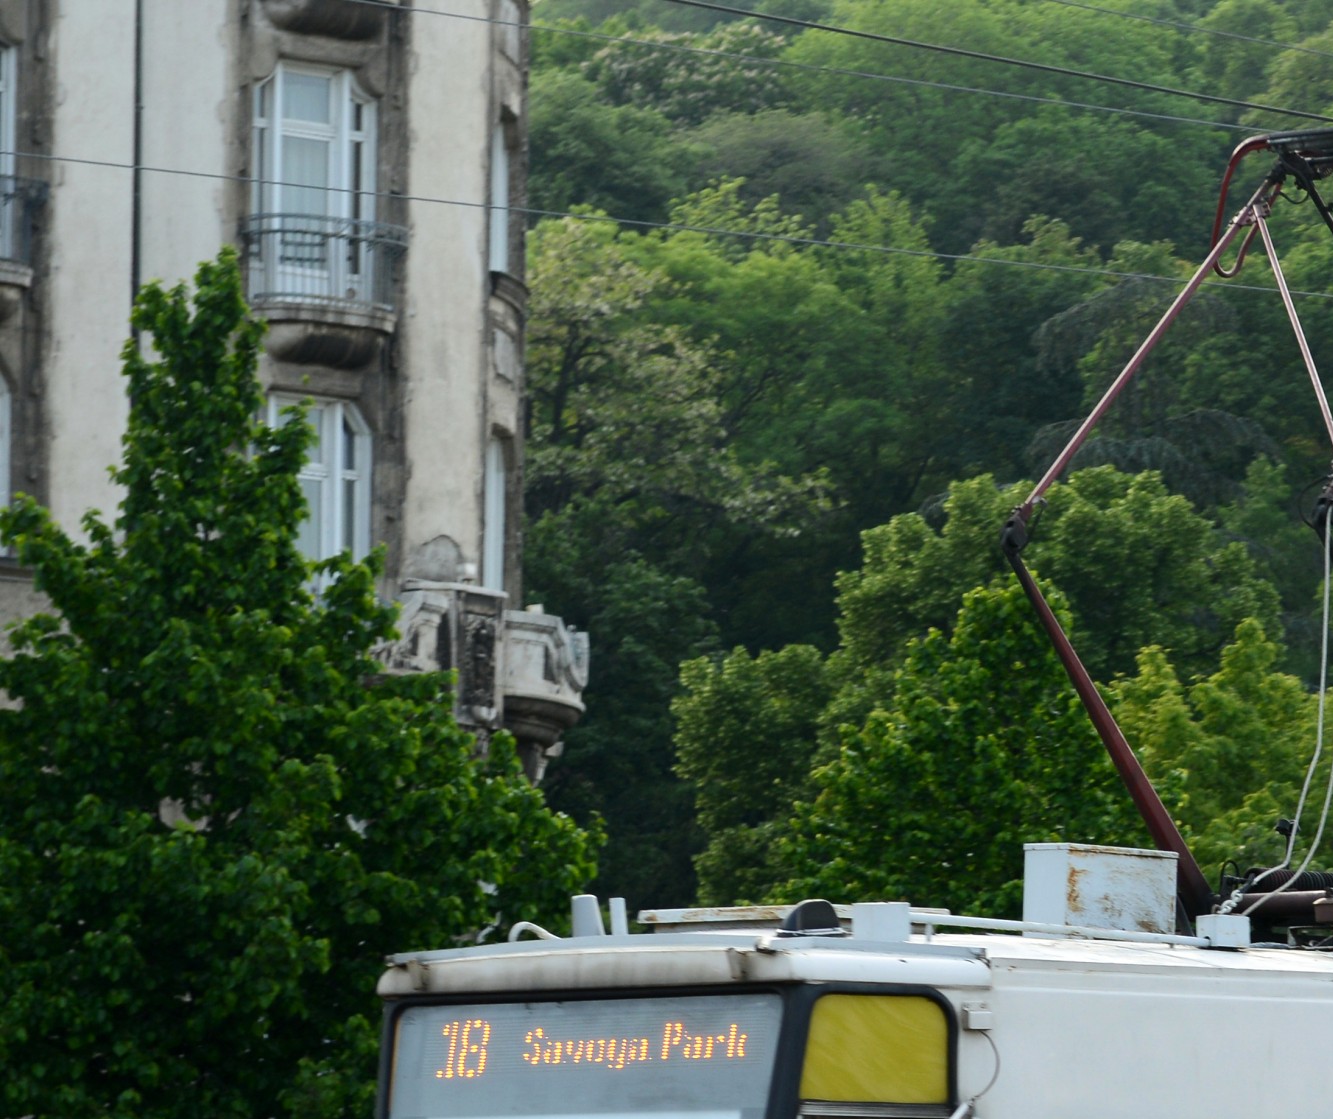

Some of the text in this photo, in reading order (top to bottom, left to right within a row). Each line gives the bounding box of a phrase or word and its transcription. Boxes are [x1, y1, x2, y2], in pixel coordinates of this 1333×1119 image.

[436, 1019, 748, 1079] 18 Savoya Park
